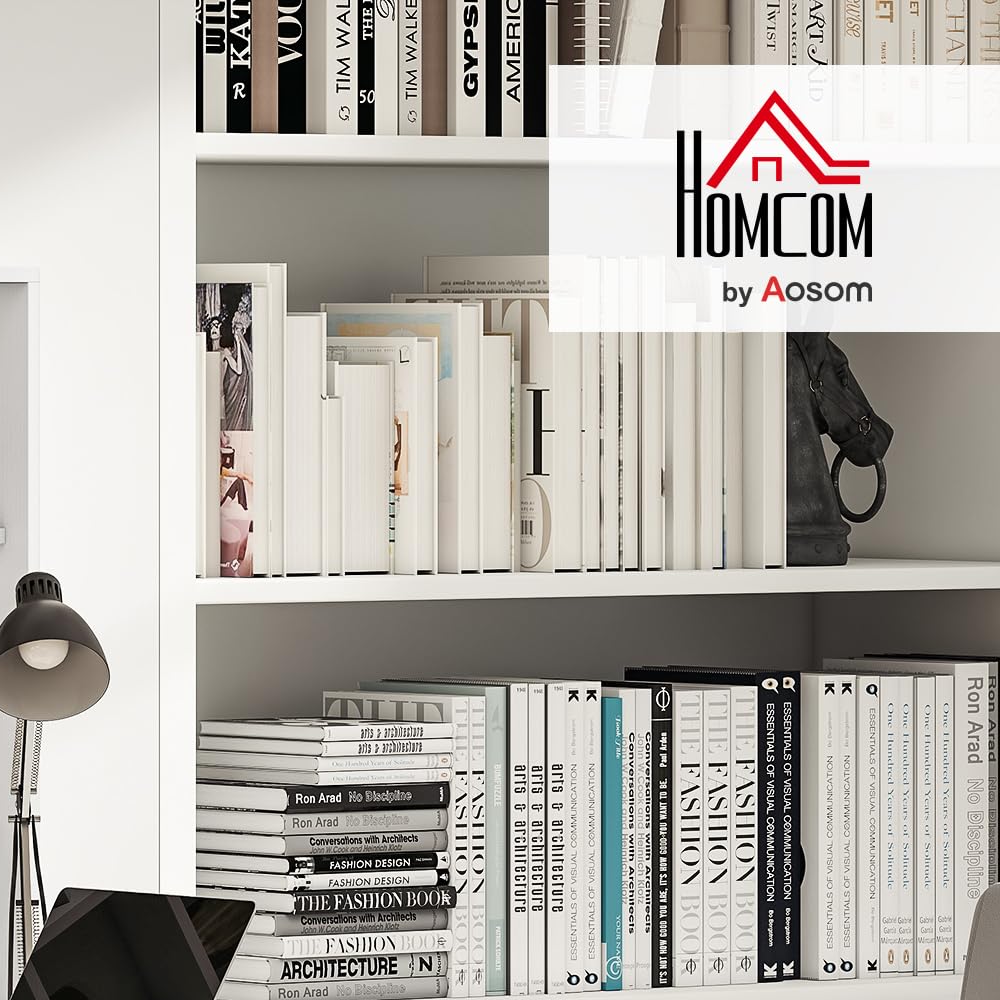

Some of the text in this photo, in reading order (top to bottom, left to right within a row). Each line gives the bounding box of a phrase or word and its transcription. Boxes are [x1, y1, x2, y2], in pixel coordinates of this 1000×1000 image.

[363, 8, 373, 40] THE
[464, 0, 478, 97] GYPS
[336, 57, 350, 93] TIM
[405, 69, 417, 100] TIM
[360, 90, 375, 103] 50
[360, 727, 374, 739] arts
[358, 742, 372, 754] arts
[659, 732, 668, 768] Paul Arden
[514, 764, 527, 794] arts
[531, 765, 544, 794] arts
[552, 764, 564, 793] arts
[869, 766, 876, 780] OF
[295, 793, 316, 804] Ron
[318, 792, 342, 803] Arad
[348, 791, 363, 803] No
[659, 791, 668, 800] TO
[963, 677, 984, 899] Ron Arad No Discipline
[659, 801, 668, 820] WANT
[766, 703, 775, 902] ESSENTIALS OF VISUAL COMMUNICATION
[783, 702, 792, 900] ESSENTIALS OF VISUAL COMMUNICATION
[292, 817, 313, 828] Ron
[315, 816, 339, 828] Arad
[681, 763, 700, 885] FASHION
[708, 762, 728, 884] FASHION
[735, 759, 755, 882] FASHION
[309, 833, 419, 846] Conversations with Architects
[456, 770, 468, 894] FASHION
[472, 770, 484, 893] FASHION
[330, 858, 411, 870] FASHION DESIGN
[514, 820, 527, 913] architecture
[531, 820, 544, 912] architecture
[552, 820, 564, 913] architecture
[659, 856, 668, 872] HOW
[328, 876, 410, 887] FASHION DESIGN
[826, 875, 833, 890] OF
[844, 875, 851, 889] OF
[297, 894, 331, 912] THE
[334, 891, 403, 911] FASHION
[570, 887, 577, 900] OF
[588, 886, 595, 900] OF
[301, 911, 417, 926] Conversations with Architects
[659, 904, 668, 919] YOU
[659, 920, 668, 938] GOOD
[325, 935, 396, 954] FASHION
[659, 938, 668, 955] HOW
[280, 956, 398, 980] ARCHITECTURE
[418, 956, 433, 971] N
[659, 956, 668, 969] NOT
[278, 988, 300, 999] Ron
[303, 987, 329, 997] Arad
